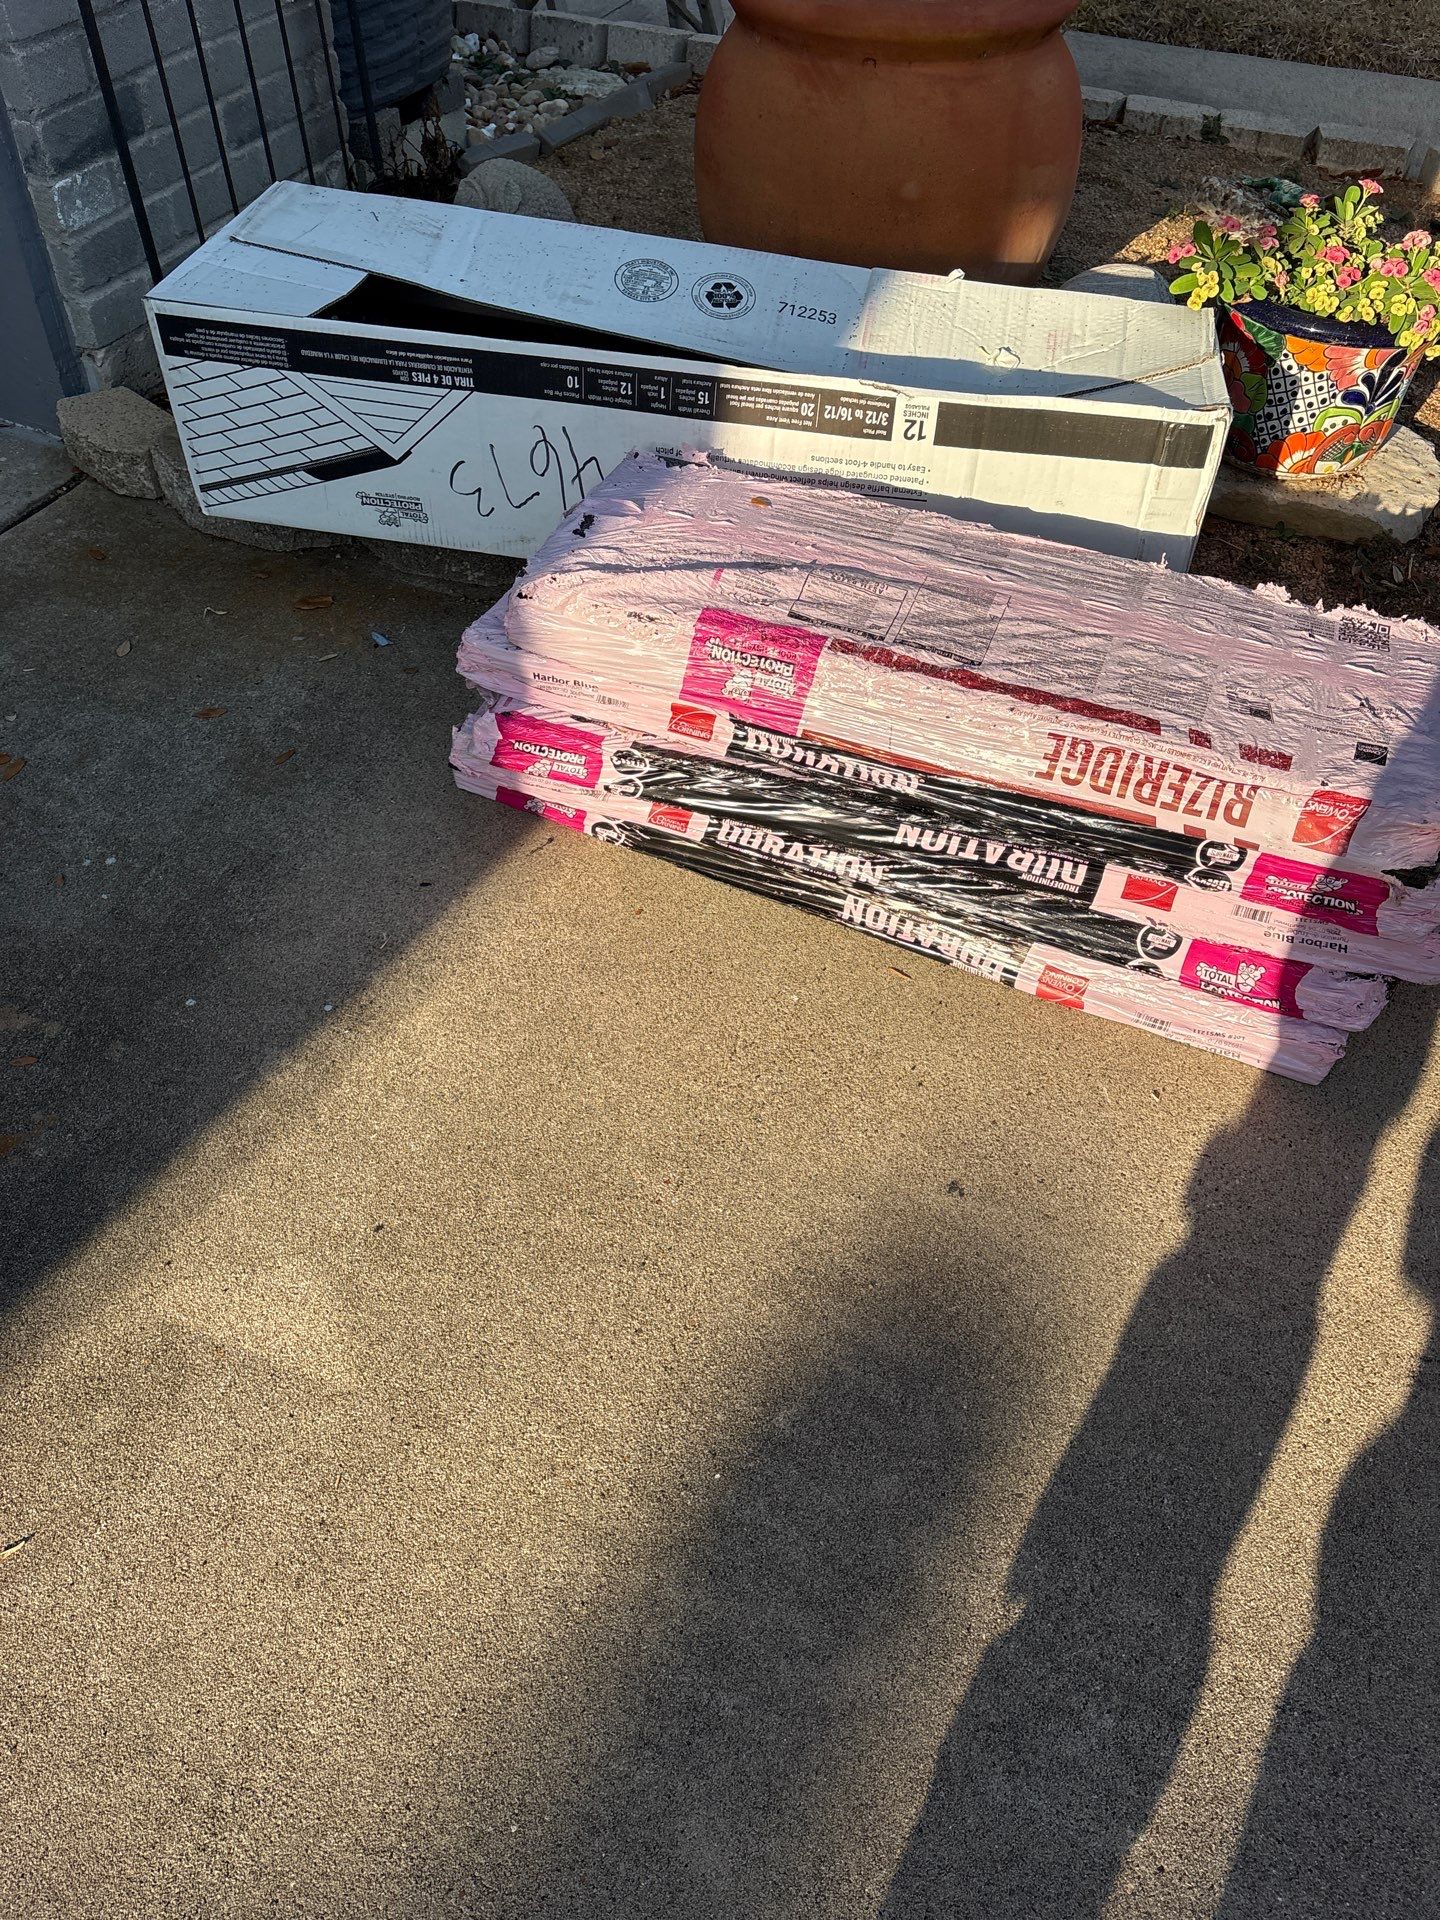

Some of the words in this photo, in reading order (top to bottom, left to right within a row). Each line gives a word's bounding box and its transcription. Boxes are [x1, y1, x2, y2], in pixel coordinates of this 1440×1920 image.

[778, 301, 837, 326] 712253
[395, 360, 408, 368] PARA
[443, 365, 473, 374] VENTILACIÓN
[411, 371, 431, 384] PIES
[433, 373, 439, 384] 4
[440, 374, 453, 386] DE
[454, 376, 475, 388] TIRA
[566, 375, 580, 389] 10
[620, 381, 633, 395] 12
[660, 386, 666, 400] 1
[563, 391, 580, 399] Pieces
[697, 391, 710, 405] 15
[677, 405, 693, 413] Width
[800, 402, 816, 417] 20
[824, 404, 853, 422] 16/12
[854, 409, 863, 419] to
[903, 409, 929, 419] INCHES
[766, 415, 779, 423] Area
[791, 418, 803, 426] Free
[865, 410, 890, 426] 3/12
[862, 427, 875, 435] Pitch
[903, 418, 927, 442] 12
[655, 446, 674, 456] pitch
[810, 455, 843, 465] sections
[844, 458, 868, 468] 4-foot
[869, 461, 896, 471] handle
[798, 464, 823, 474] design
[825, 468, 845, 476] ridge
[898, 464, 906, 472] to
[907, 463, 926, 474] Easy
[789, 474, 816, 487] deflect
[846, 471, 888, 481] corrugated
[889, 475, 925, 486] Patented
[818, 478, 839, 488] helps
[840, 480, 865, 491] design
[867, 484, 889, 494] baffle
[892, 487, 923, 497] External
[362, 497, 422, 511] PROTECTION
[400, 511, 423, 519] TOTAL
[709, 645, 794, 677] PROTECTION
[532, 672, 571, 686] Harbor
[671, 723, 711, 738] CORNING
[513, 741, 586, 765] PROTECTION
[554, 763, 582, 775] TOTAL
[1034, 733, 1261, 828] RIZERIDGE
[1307, 800, 1349, 820] OWENS
[650, 817, 687, 833] CORNING
[717, 819, 885, 884] DURATION
[895, 823, 1088, 886] DURATION
[1021, 872, 1080, 894] TRUDEFINITION
[839, 895, 1002, 977] DURATION
[1263, 931, 1295, 944] Blue
[1298, 937, 1348, 954] Harbor
[1042, 969, 1086, 985] CORNING
[1203, 969, 1233, 986] TOTAL
[1040, 976, 1076, 992] OWENS
[1193, 1028, 1226, 1038] SWS1211
